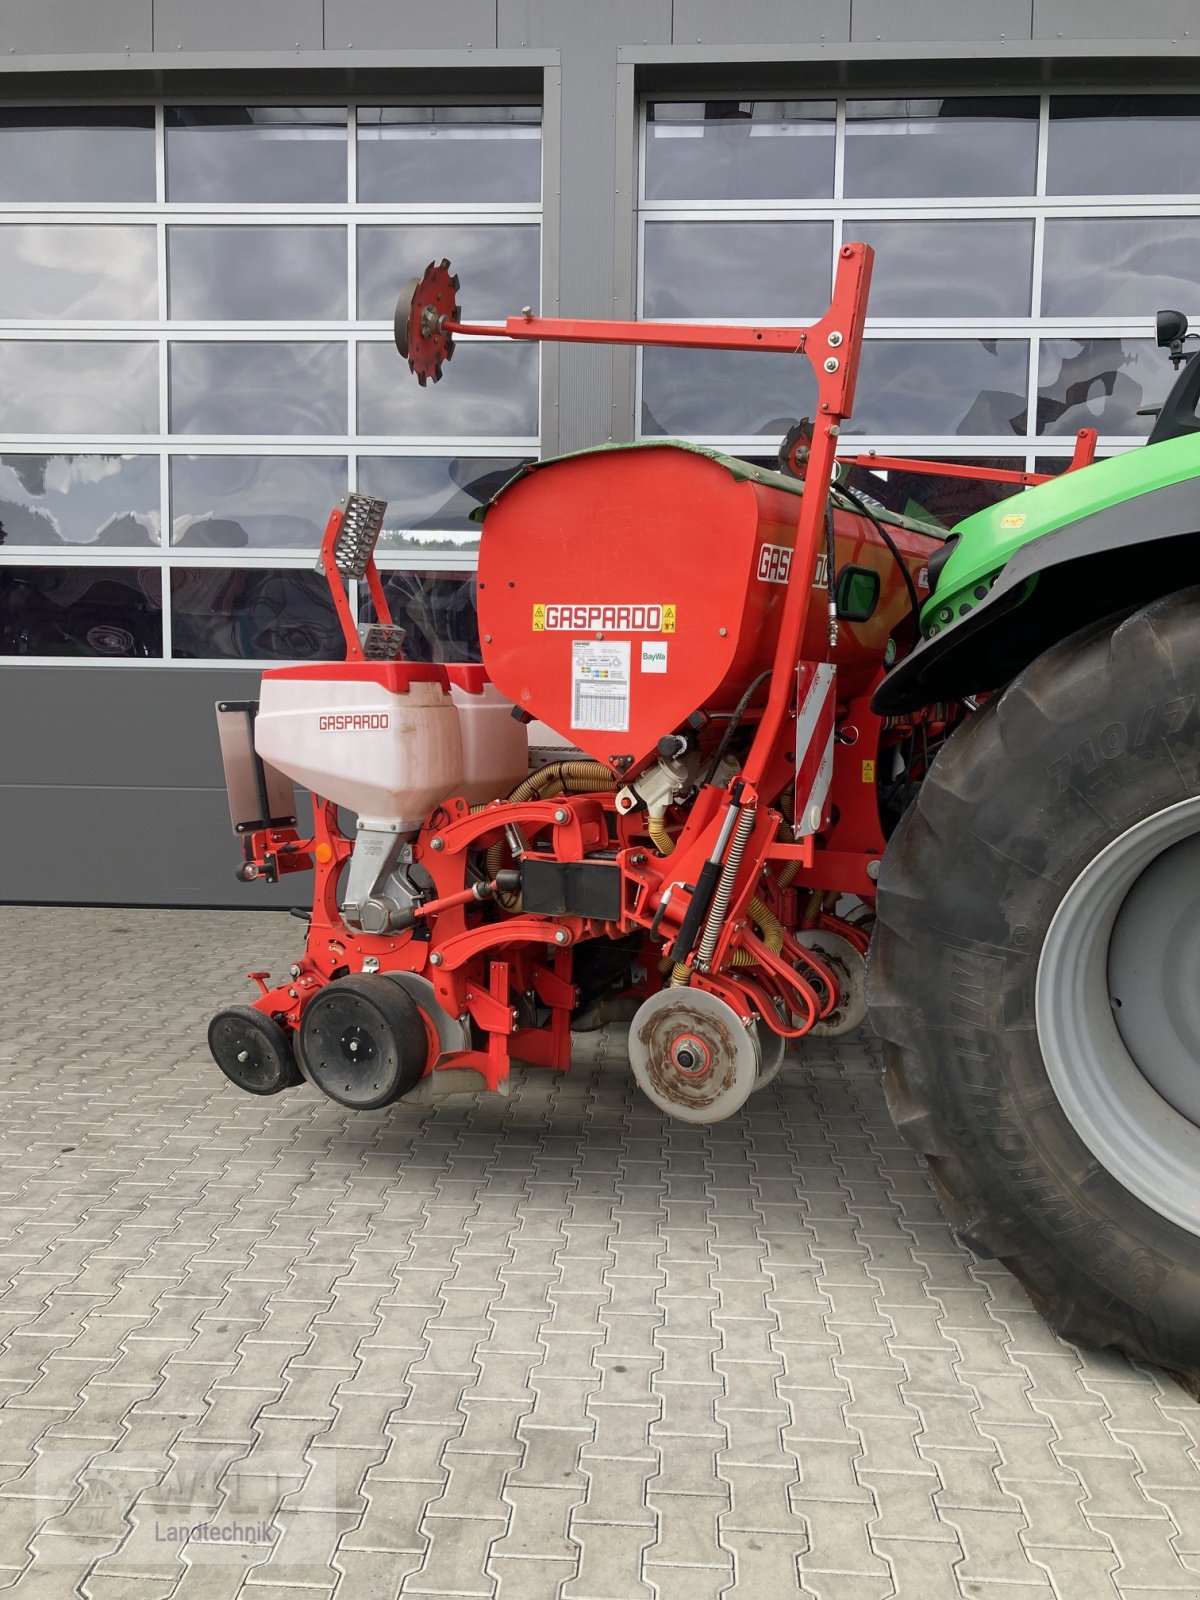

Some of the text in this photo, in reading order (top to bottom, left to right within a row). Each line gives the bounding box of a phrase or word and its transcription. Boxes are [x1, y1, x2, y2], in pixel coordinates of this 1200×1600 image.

[545, 606, 662, 630] GASPARDO
[642, 651, 667, 662] BayWa
[318, 713, 390, 732] GASPARDO
